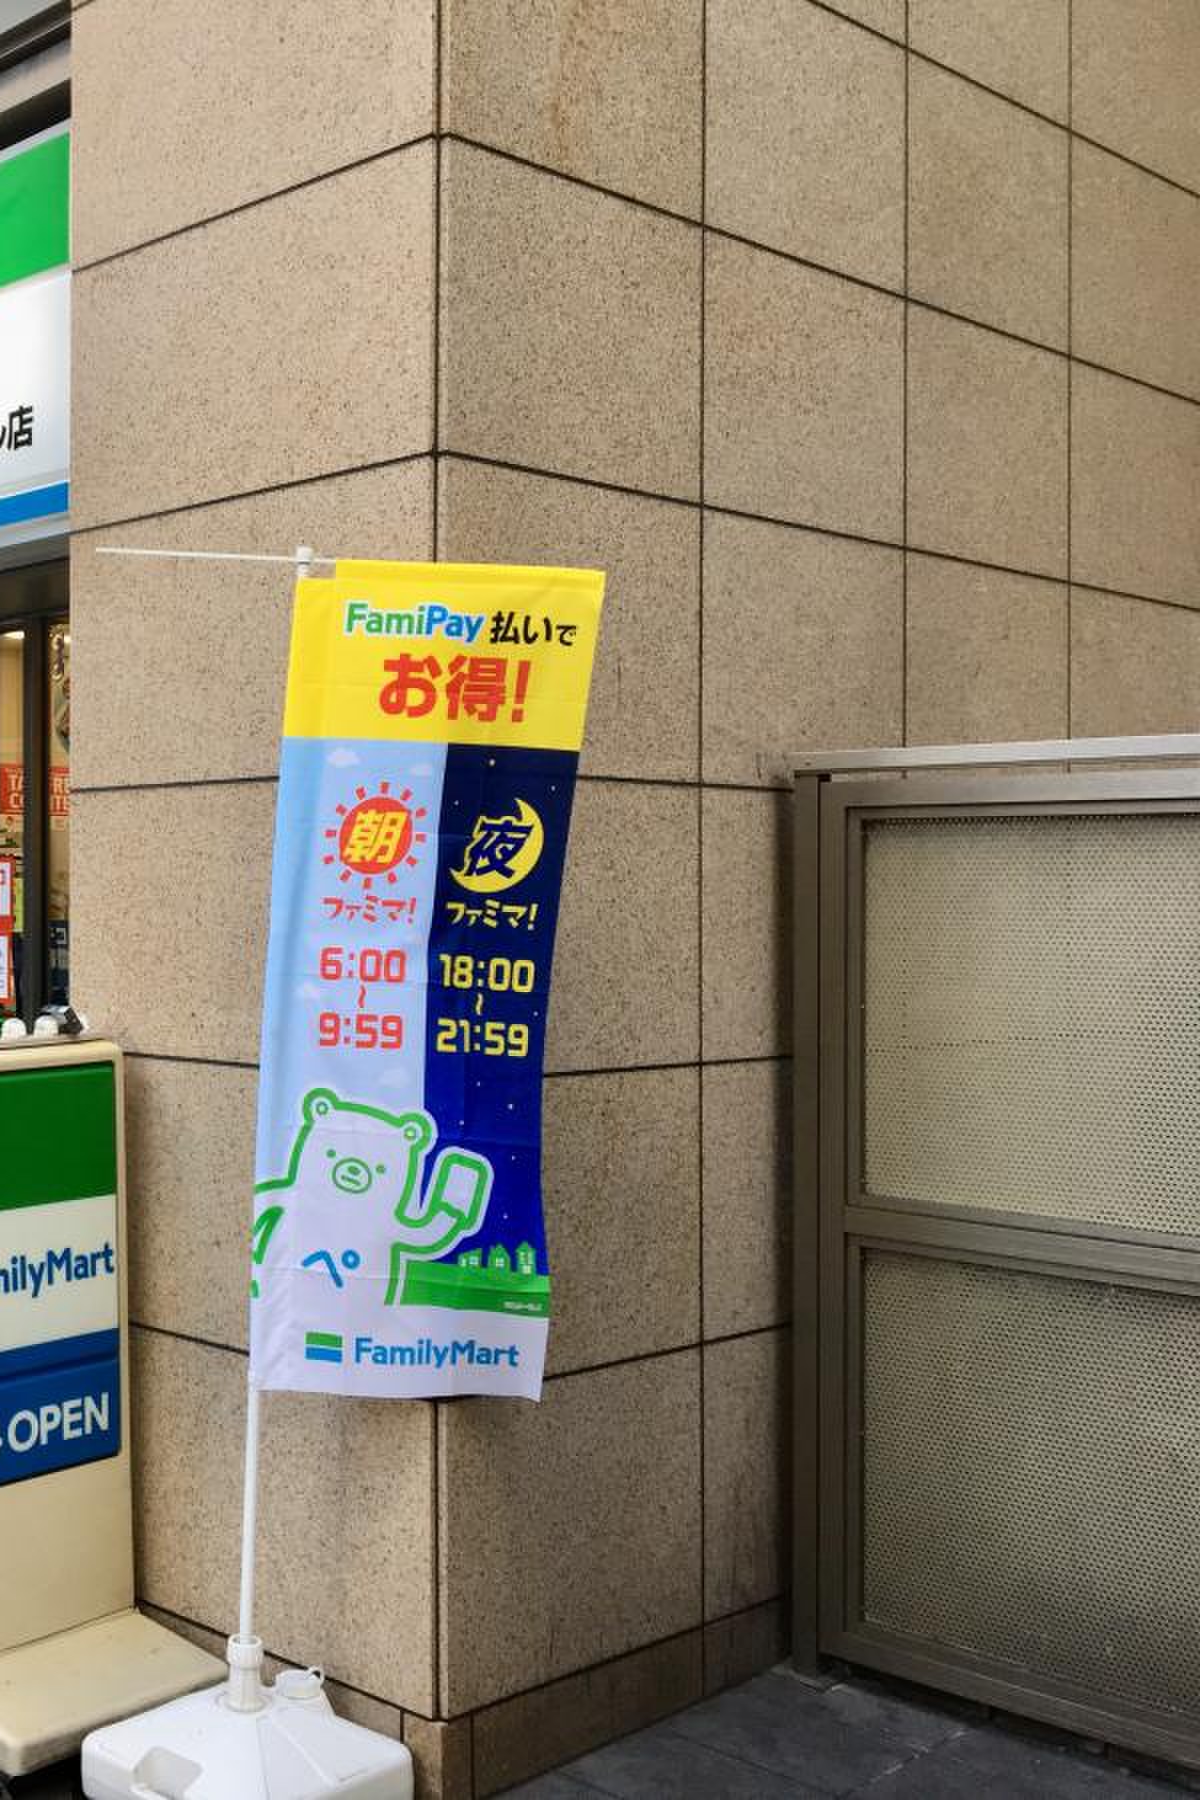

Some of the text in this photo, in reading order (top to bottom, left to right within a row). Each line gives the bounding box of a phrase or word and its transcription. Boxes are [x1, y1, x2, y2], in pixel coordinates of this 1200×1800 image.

[344, 602, 577, 646] FamiPay 払いで
[378, 653, 532, 723] お得!
[342, 809, 409, 864] 朝
[464, 820, 536, 879] 夜
[322, 894, 417, 924] ファミマ!
[446, 898, 539, 930] ファミマ!
[319, 946, 407, 983] 6:00
[439, 953, 536, 993] 18:00
[319, 1011, 404, 1050] 9:59
[436, 1018, 530, 1058] 21:59
[354, 1336, 520, 1369] FamilyMart
[6, 1391, 110, 1453] OPEN
